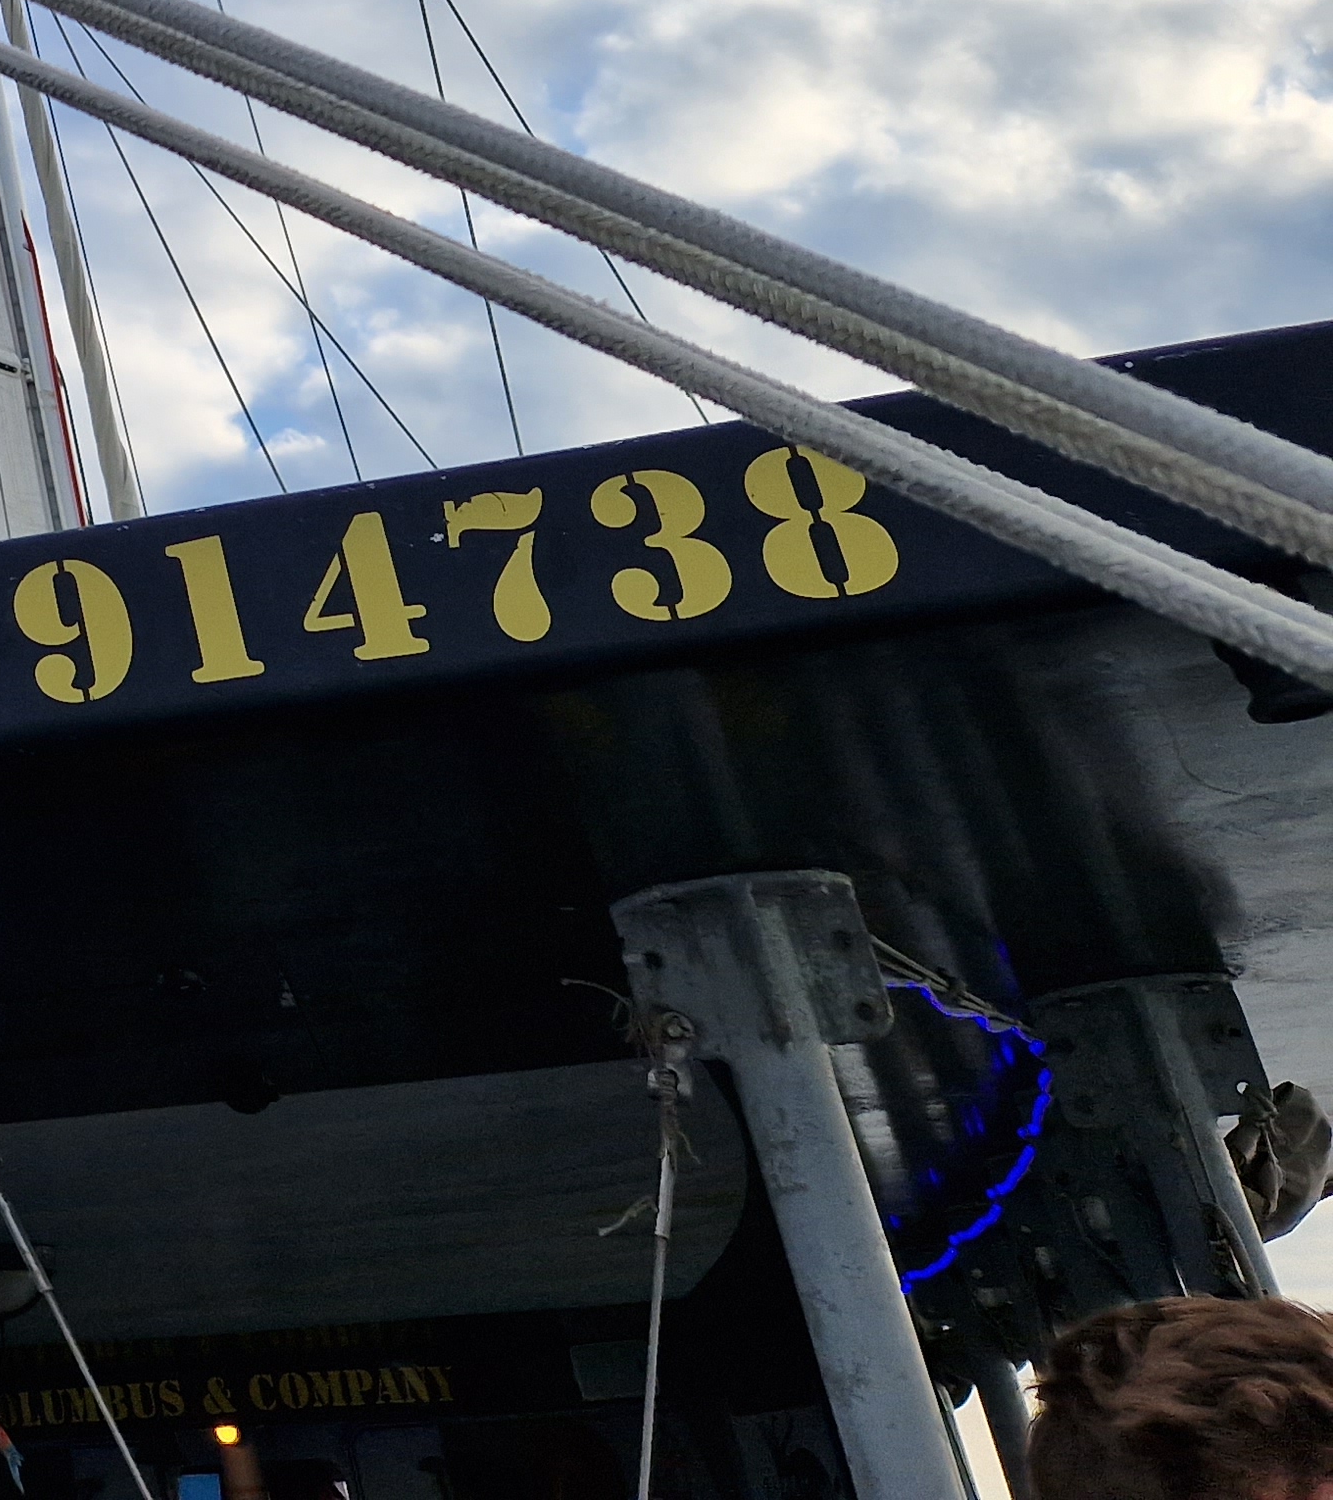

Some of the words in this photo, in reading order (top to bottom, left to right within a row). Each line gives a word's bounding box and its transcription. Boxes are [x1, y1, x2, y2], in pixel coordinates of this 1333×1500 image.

[12, 443, 900, 704] 914738
[202, 1376, 238, 1415] &
[247, 1365, 455, 1415] COMPANY
